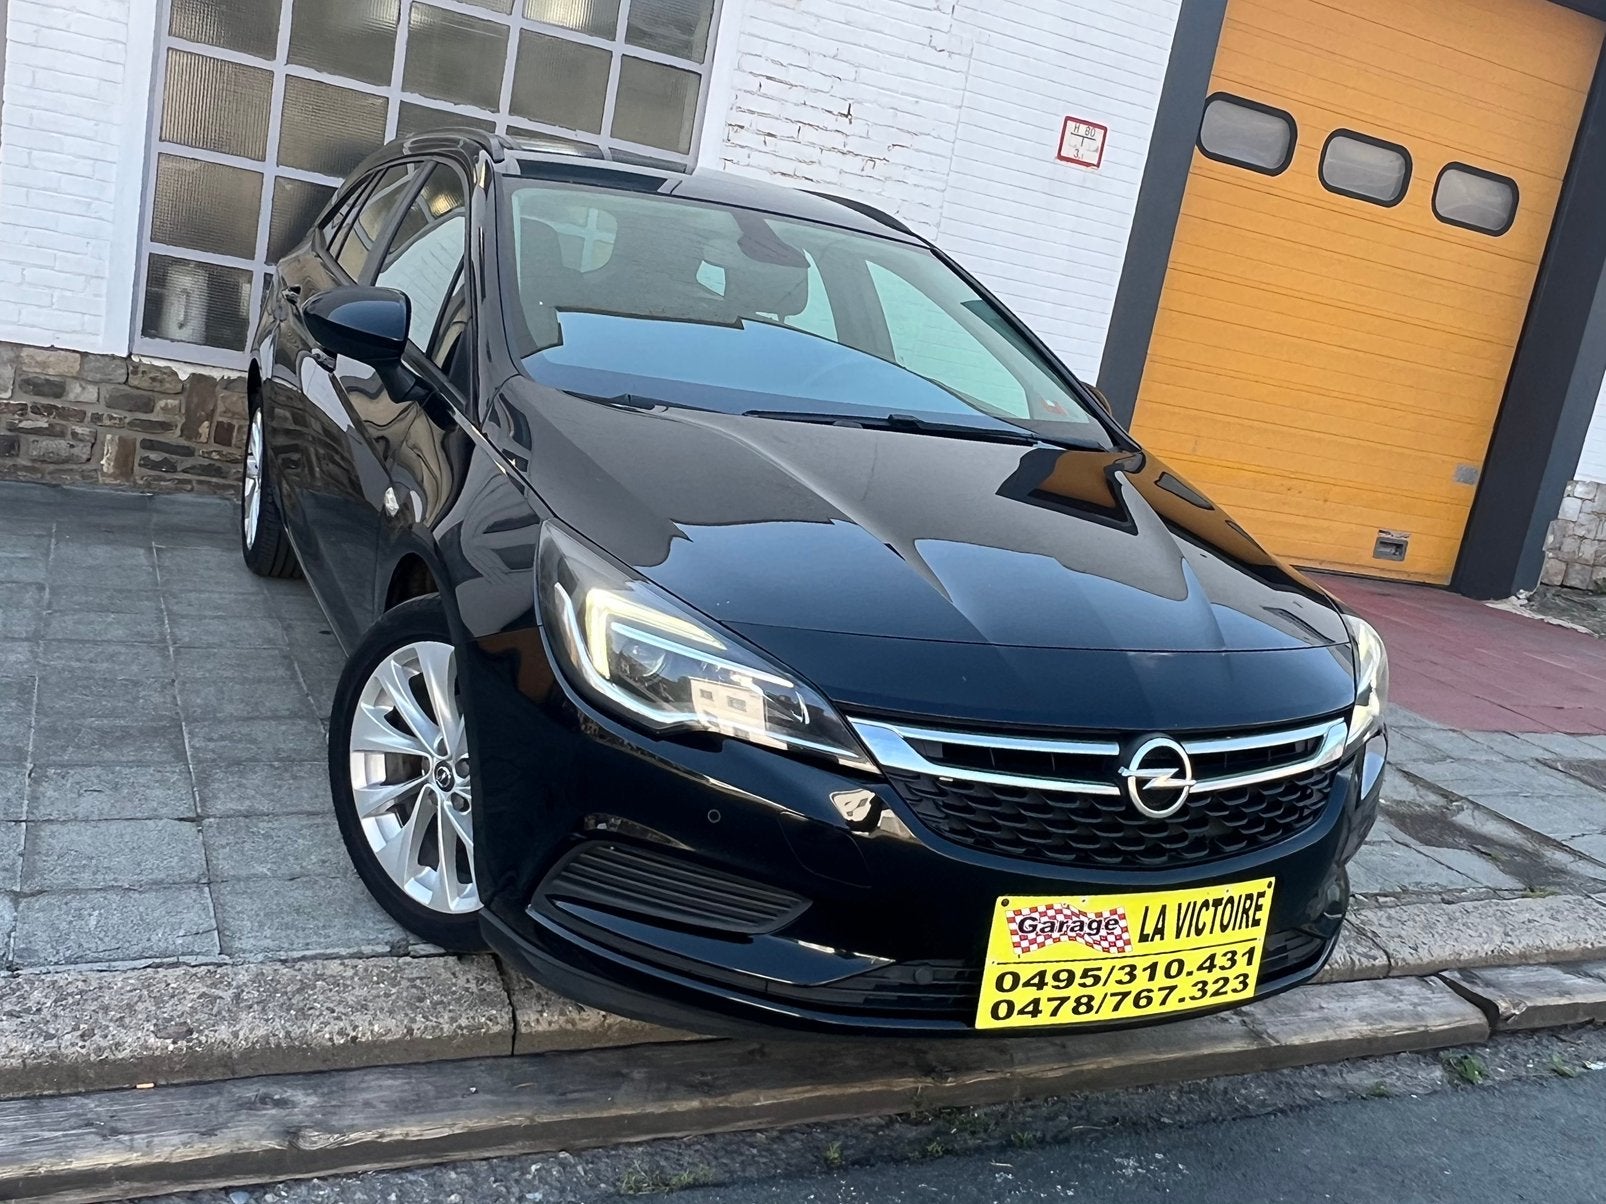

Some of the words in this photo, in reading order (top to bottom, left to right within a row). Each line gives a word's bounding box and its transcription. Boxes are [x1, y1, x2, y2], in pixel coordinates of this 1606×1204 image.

[1073, 123, 1080, 133] H
[1084, 126, 1096, 137] 80
[1017, 914, 1120, 936] Garage
[1138, 904, 1167, 943] LA
[1175, 891, 1266, 940] VICTOIRE
[995, 946, 1256, 993] 0495/310.431
[990, 972, 1250, 1021] 0478/767.323
